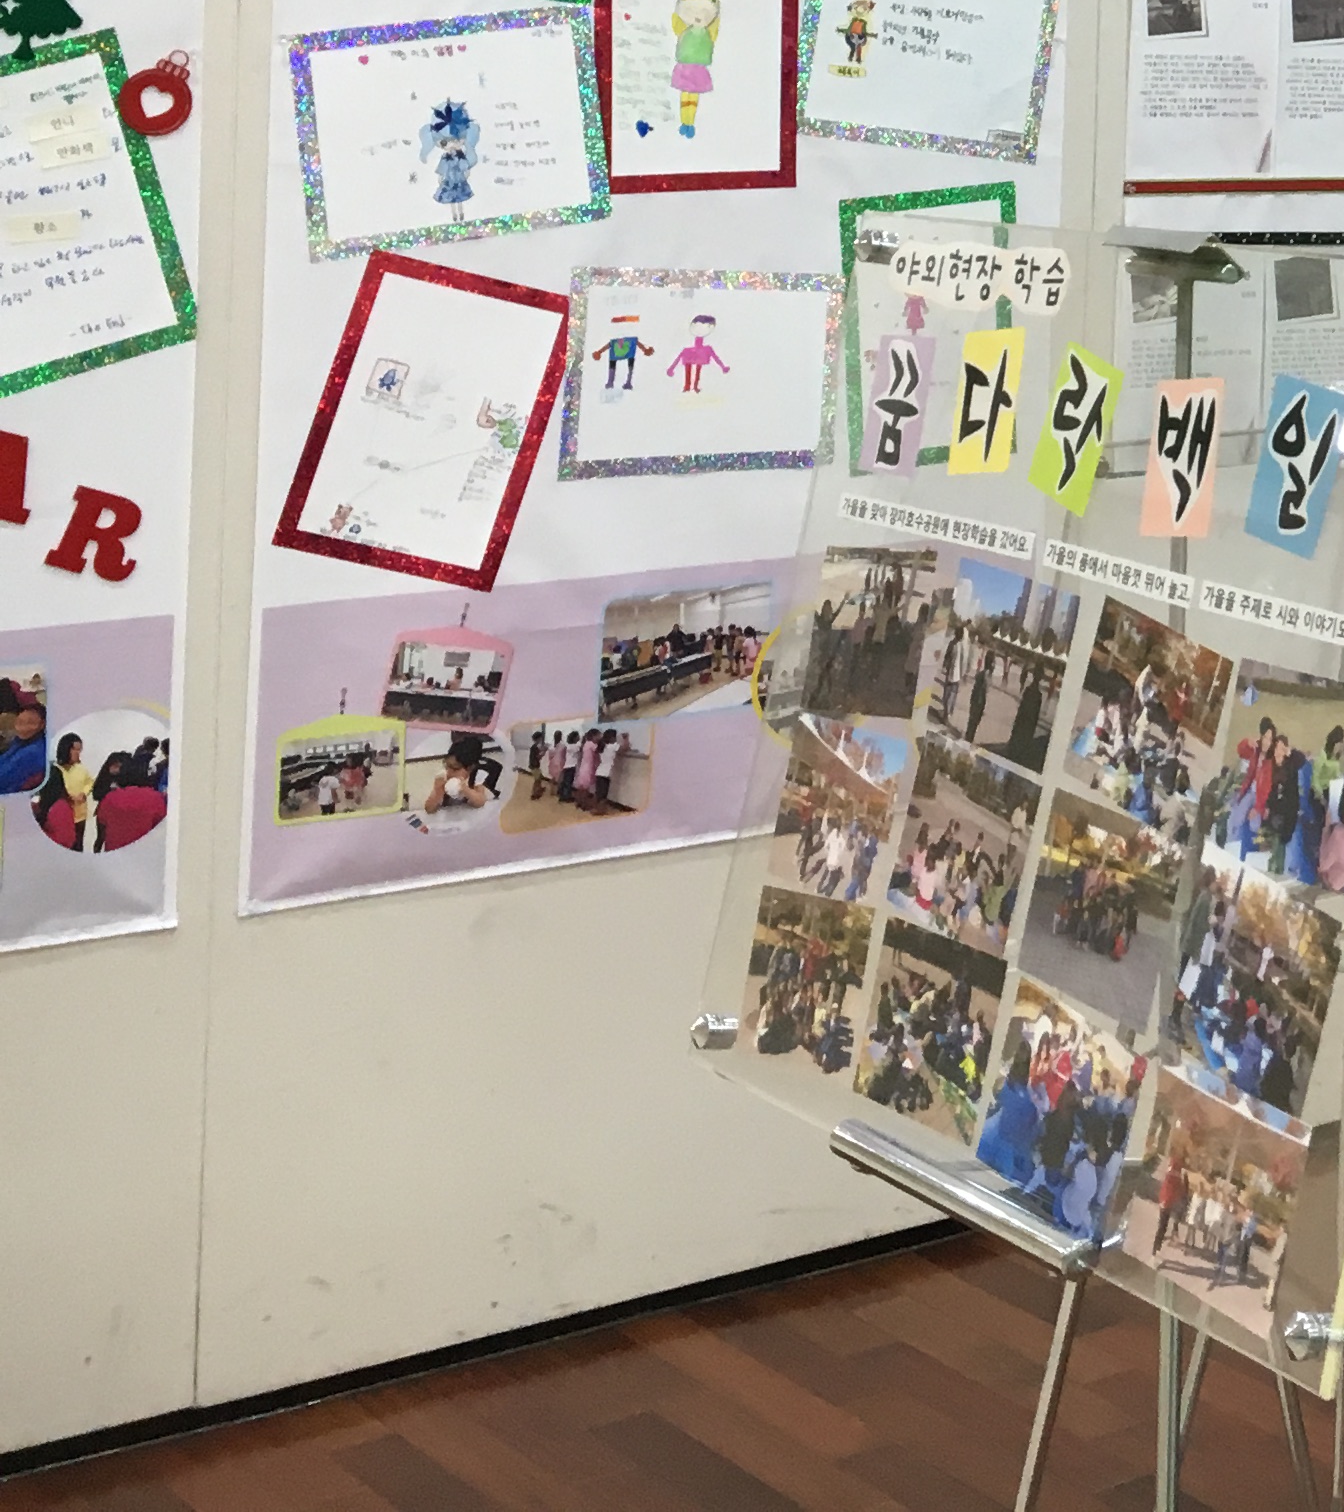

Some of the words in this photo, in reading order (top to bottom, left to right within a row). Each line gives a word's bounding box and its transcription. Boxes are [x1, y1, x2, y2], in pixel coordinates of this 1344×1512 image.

[896, 248, 1004, 303] 야외현장
[1013, 256, 1067, 307] 학습
[842, 497, 868, 519] 가을을
[952, 520, 998, 548] 현장학습을
[1047, 542, 1078, 570] 가을의
[1078, 551, 1108, 580] 품에서
[1144, 570, 1166, 596] 뛰어
[1203, 584, 1236, 613] 가을을
[1239, 592, 1273, 621] 주제로
[1275, 603, 1300, 629] 시와
